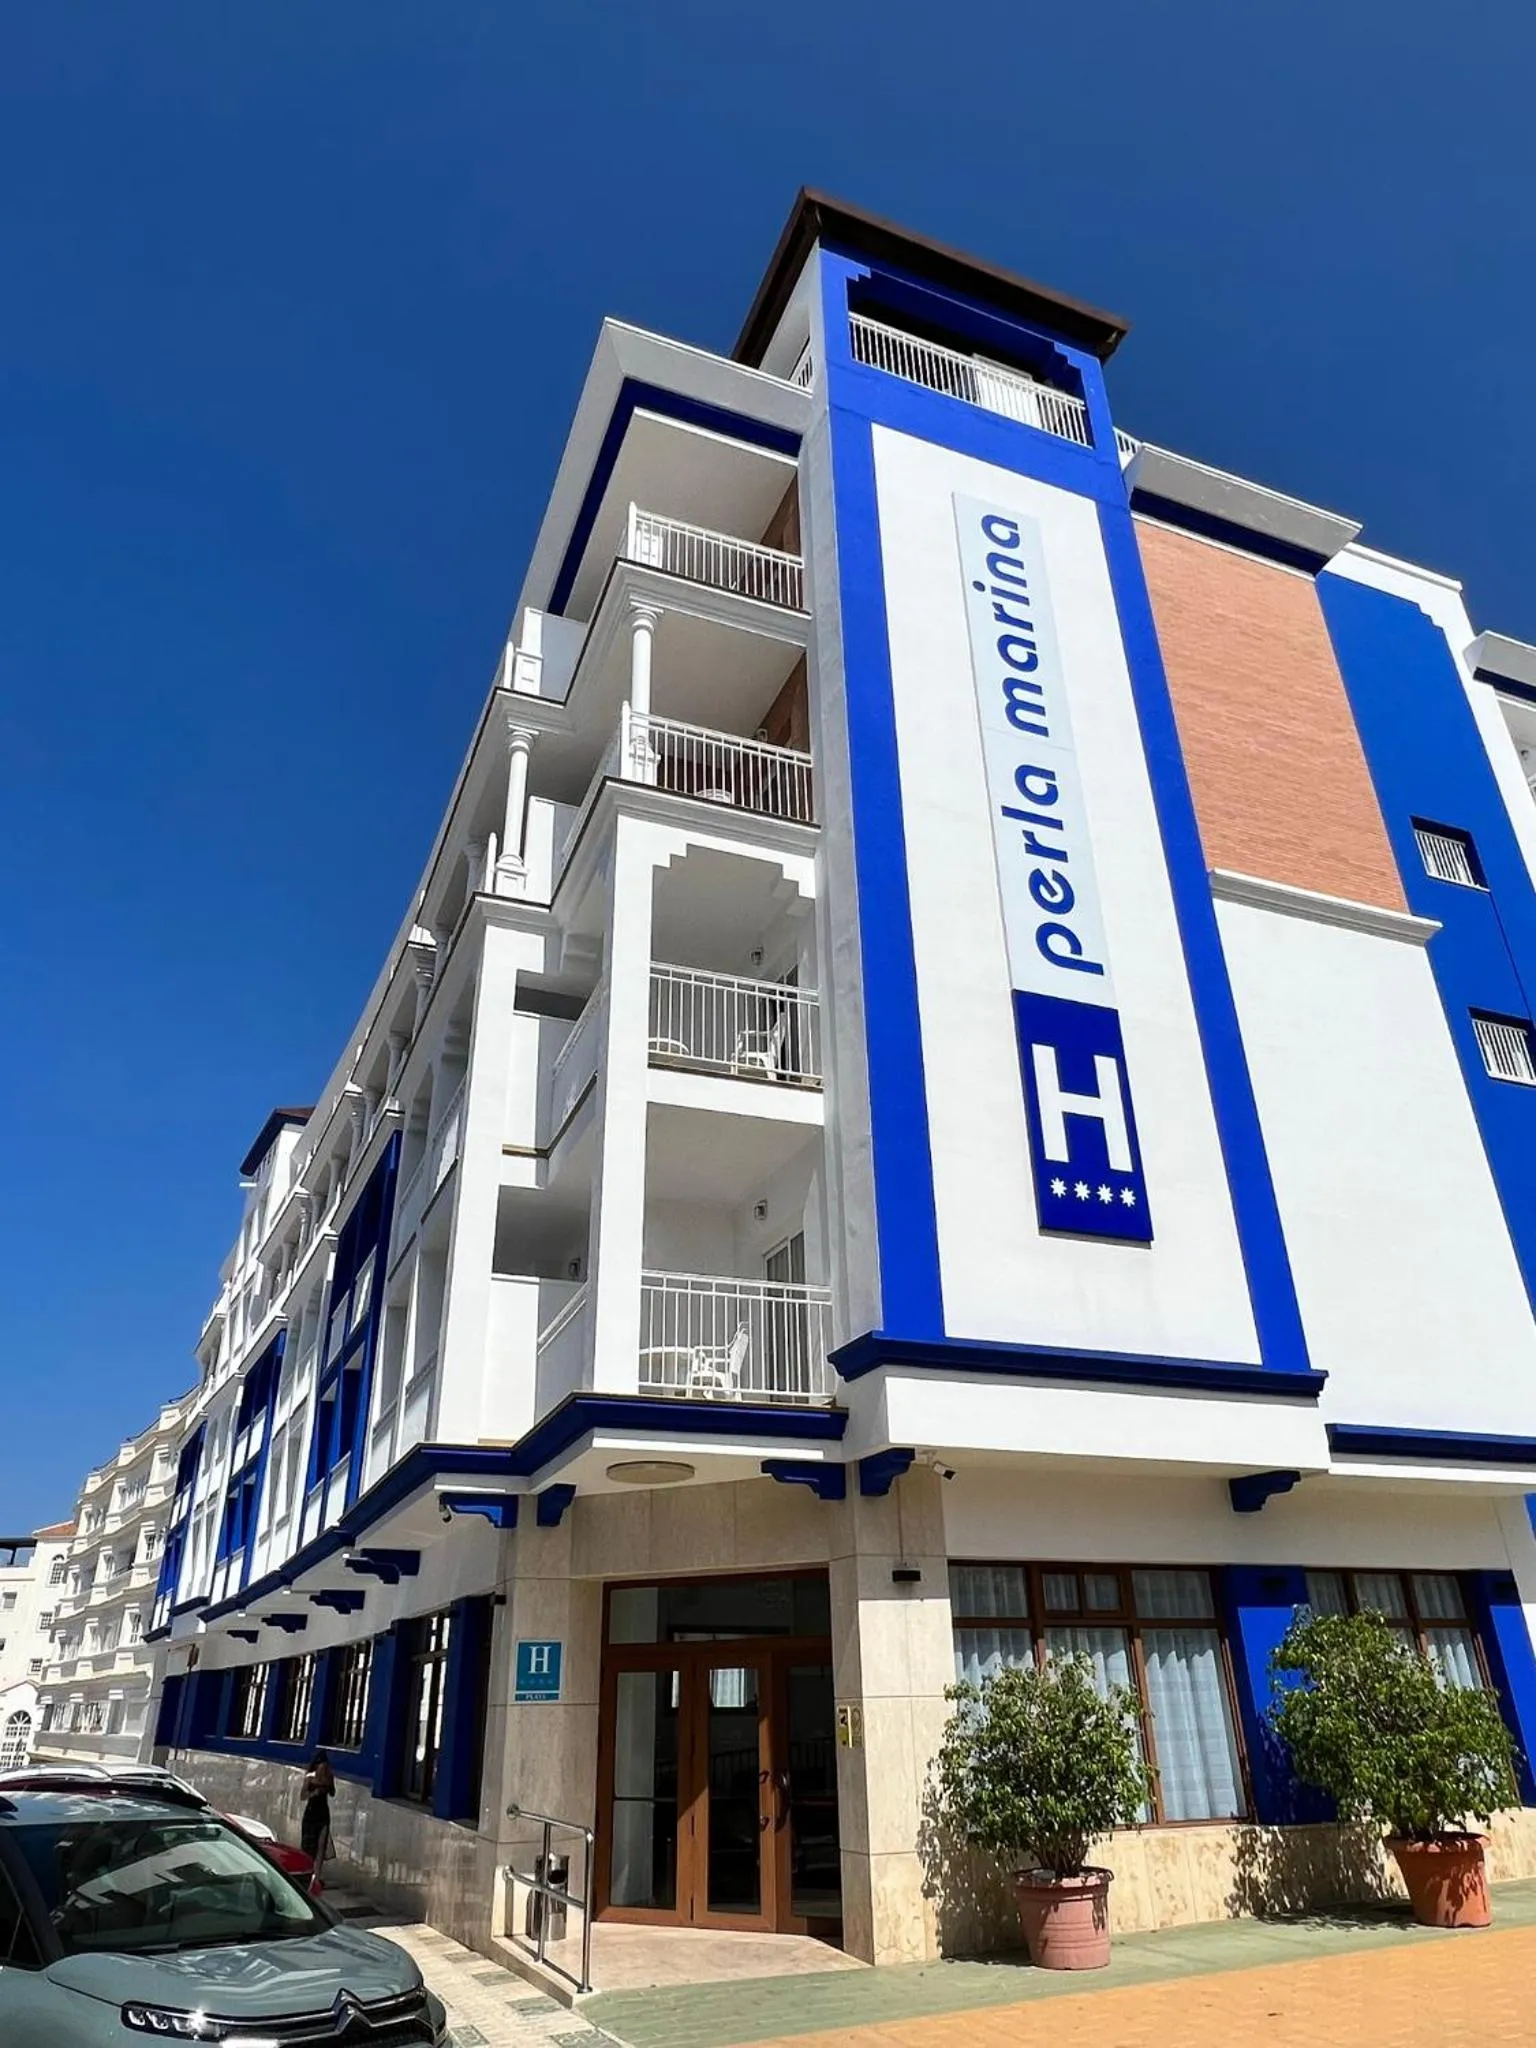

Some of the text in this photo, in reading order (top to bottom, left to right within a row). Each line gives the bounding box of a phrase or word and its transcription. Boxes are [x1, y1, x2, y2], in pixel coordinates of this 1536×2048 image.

[973, 514, 1104, 976] perla marina
[1032, 1043, 1133, 1173] H
[528, 1646, 552, 1674] H
